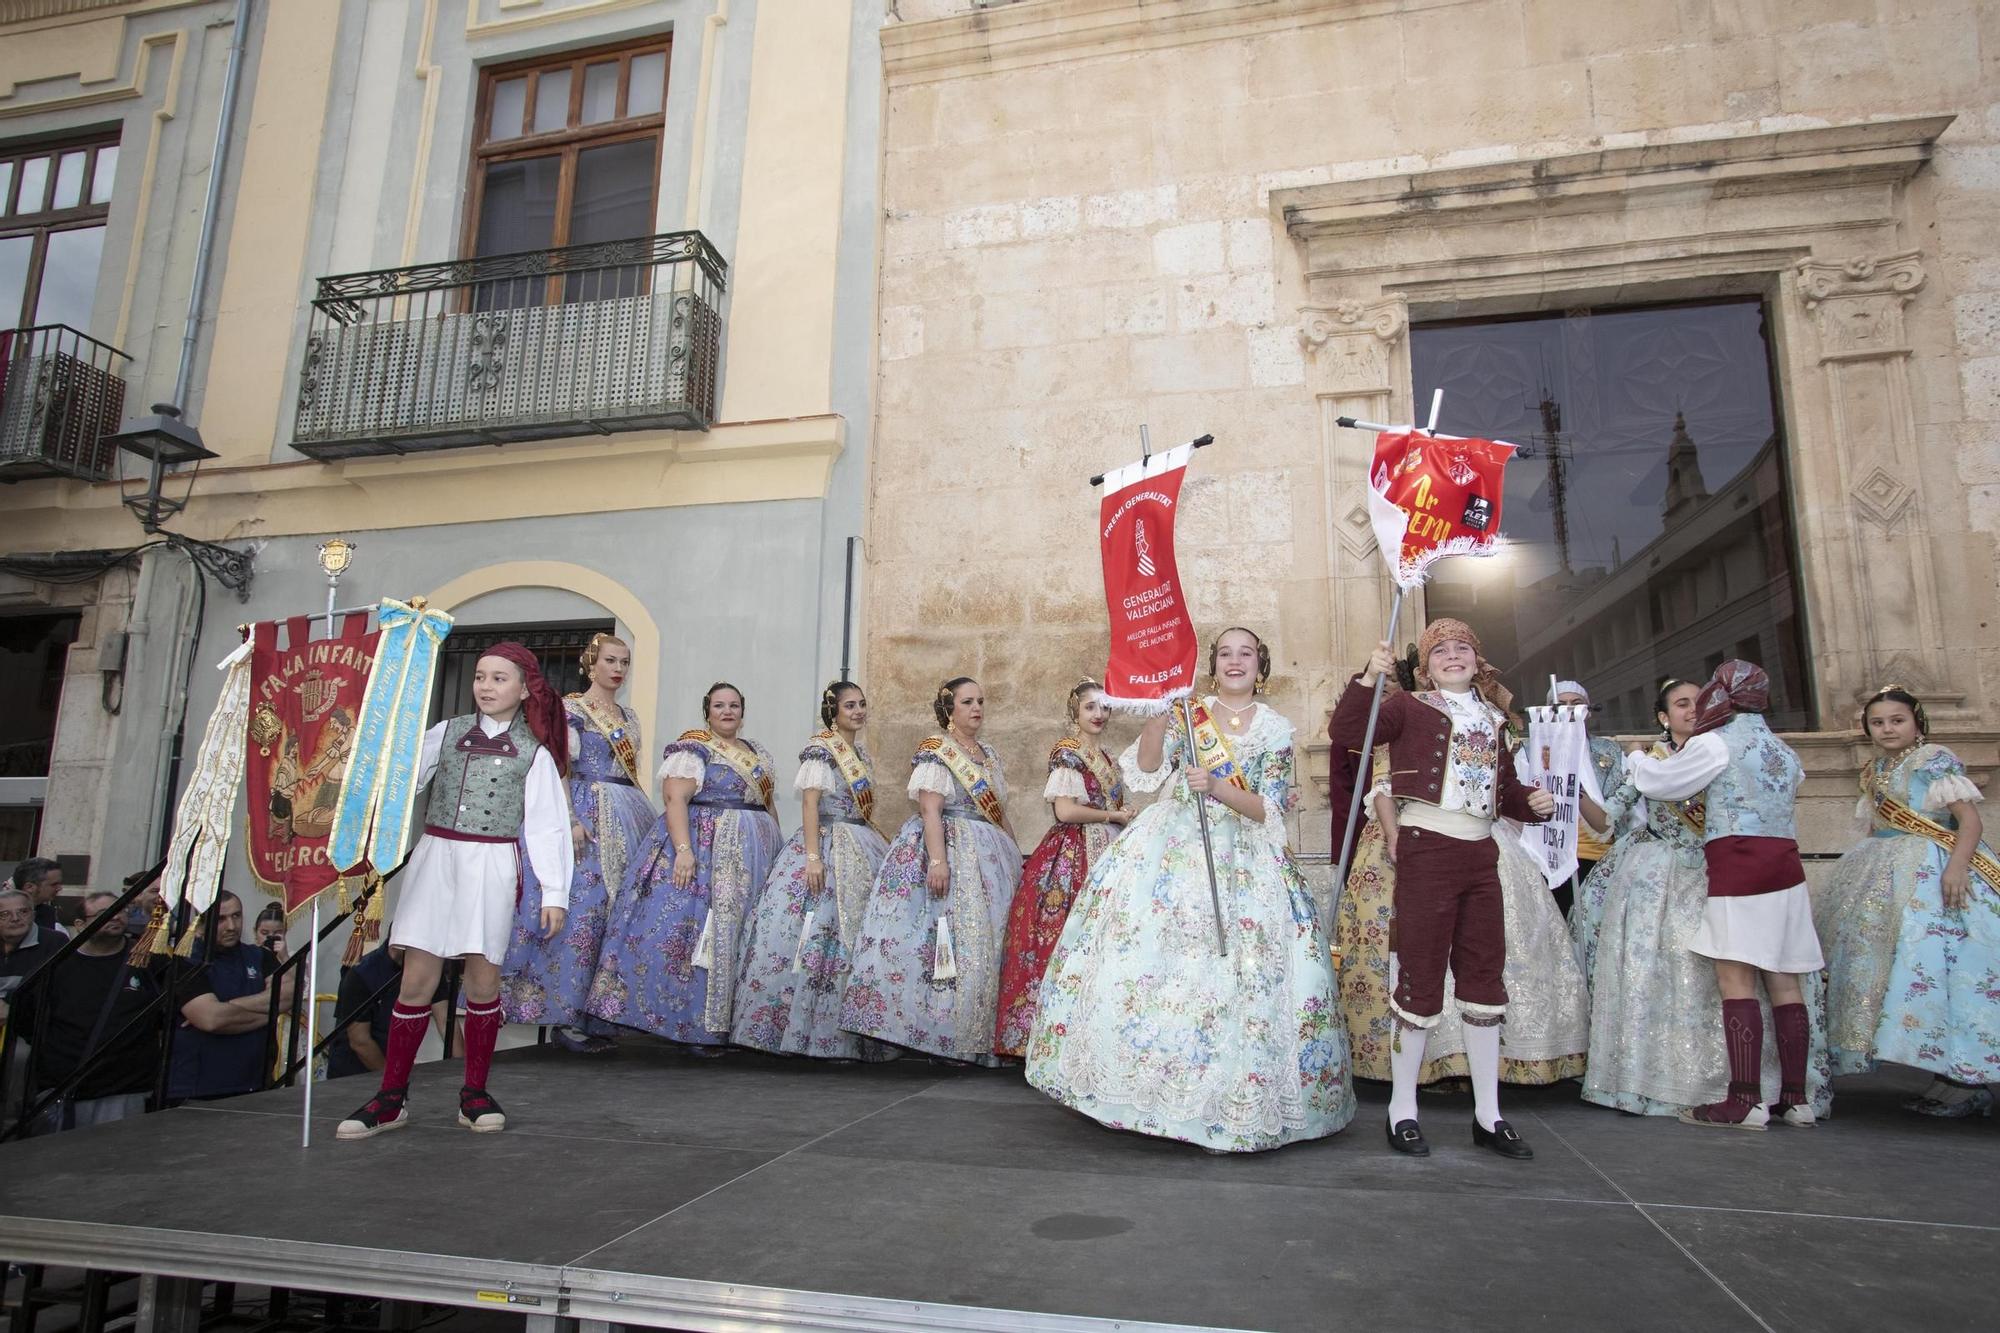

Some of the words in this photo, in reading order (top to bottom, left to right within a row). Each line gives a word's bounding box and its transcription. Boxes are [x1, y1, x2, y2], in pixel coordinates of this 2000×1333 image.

[1104, 507, 1125, 538] PREMI
[1125, 492, 1173, 508] GENERALITAT
[1464, 509, 1489, 522] FLEX
[1123, 580, 1172, 609] GENERALITAT
[1127, 595, 1175, 621] VALENCIANA
[1127, 629, 1147, 642] MILLOR
[1147, 625, 1162, 636] FALLA
[1139, 639, 1150, 649] DEL
[1151, 631, 1175, 645] MUNICIPI
[1129, 670, 1168, 684] FALLES
[1207, 752, 1225, 765] 2024
